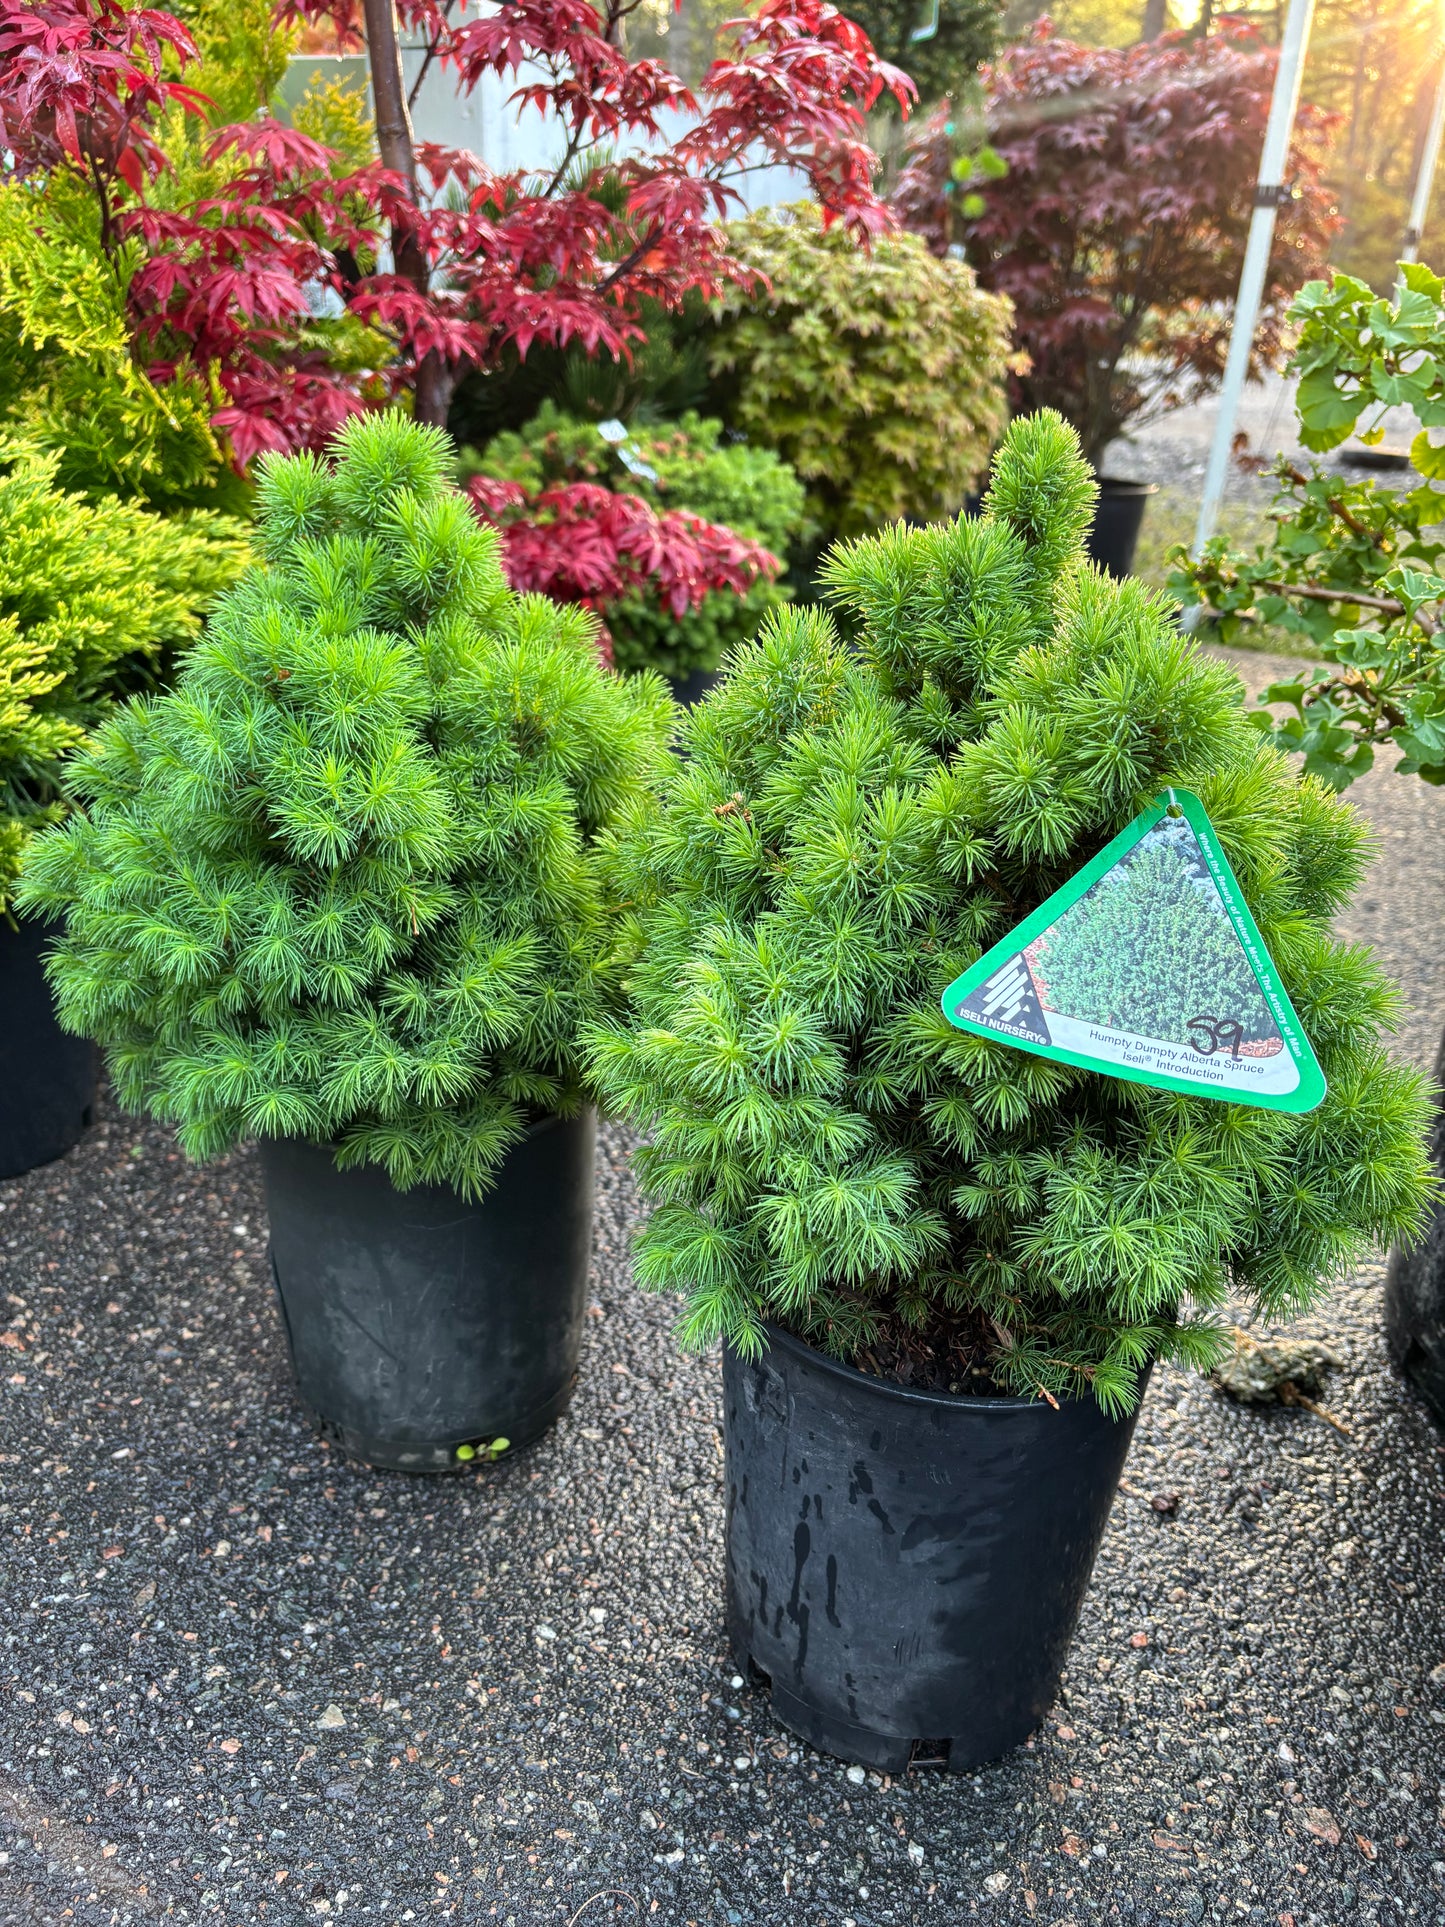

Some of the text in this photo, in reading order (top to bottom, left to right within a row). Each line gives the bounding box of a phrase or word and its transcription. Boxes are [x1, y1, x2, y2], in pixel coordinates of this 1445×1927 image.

[1199, 832, 1214, 859] Where
[1210, 860, 1220, 874] the
[1217, 875, 1234, 904] Beauty
[1230, 905, 1240, 915] of
[1235, 916, 1251, 945] Nature
[1248, 946, 1264, 973] Meets
[1261, 974, 1272, 991] The
[1269, 992, 1288, 1025] Artistry
[1284, 1026, 1294, 1037] of
[960, 1008, 987, 1026] ISELI
[1089, 1029, 1265, 1075] Humpty Dumpty Alberta Spruce
[1156, 1059, 1224, 1081] Introduction
